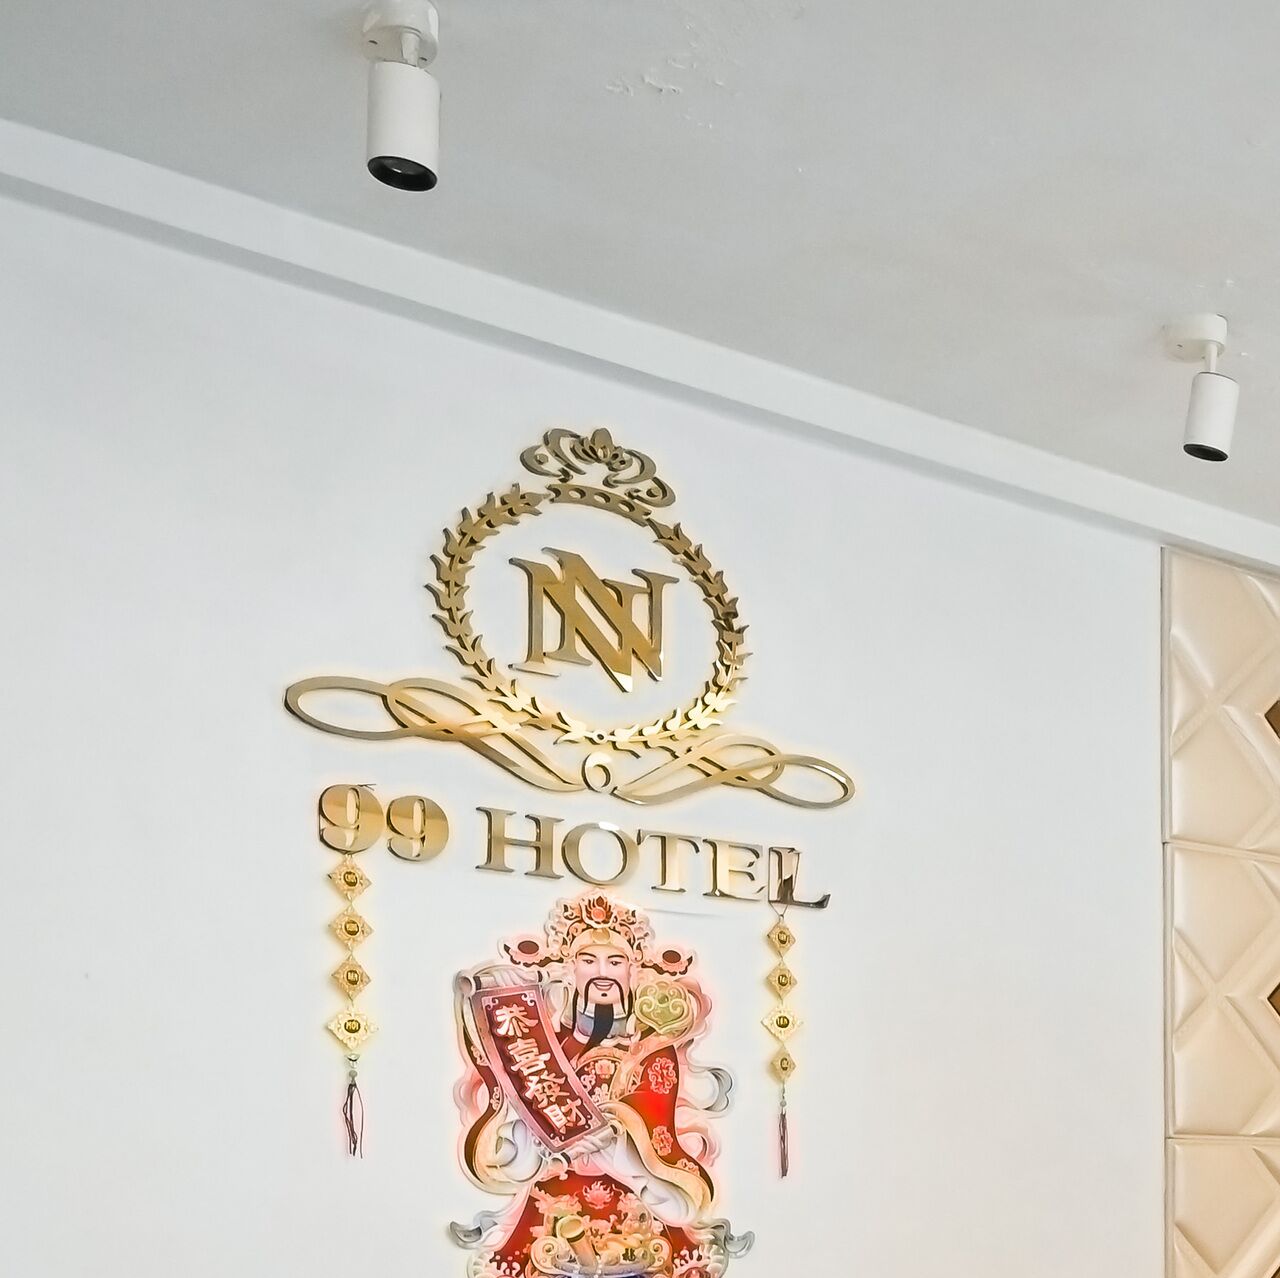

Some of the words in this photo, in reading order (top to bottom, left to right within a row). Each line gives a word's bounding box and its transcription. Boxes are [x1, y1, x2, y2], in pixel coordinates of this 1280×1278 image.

[317, 784, 449, 863] 99
[474, 806, 831, 909] HOTEL
[494, 1003, 588, 1134] 恭喜發財
